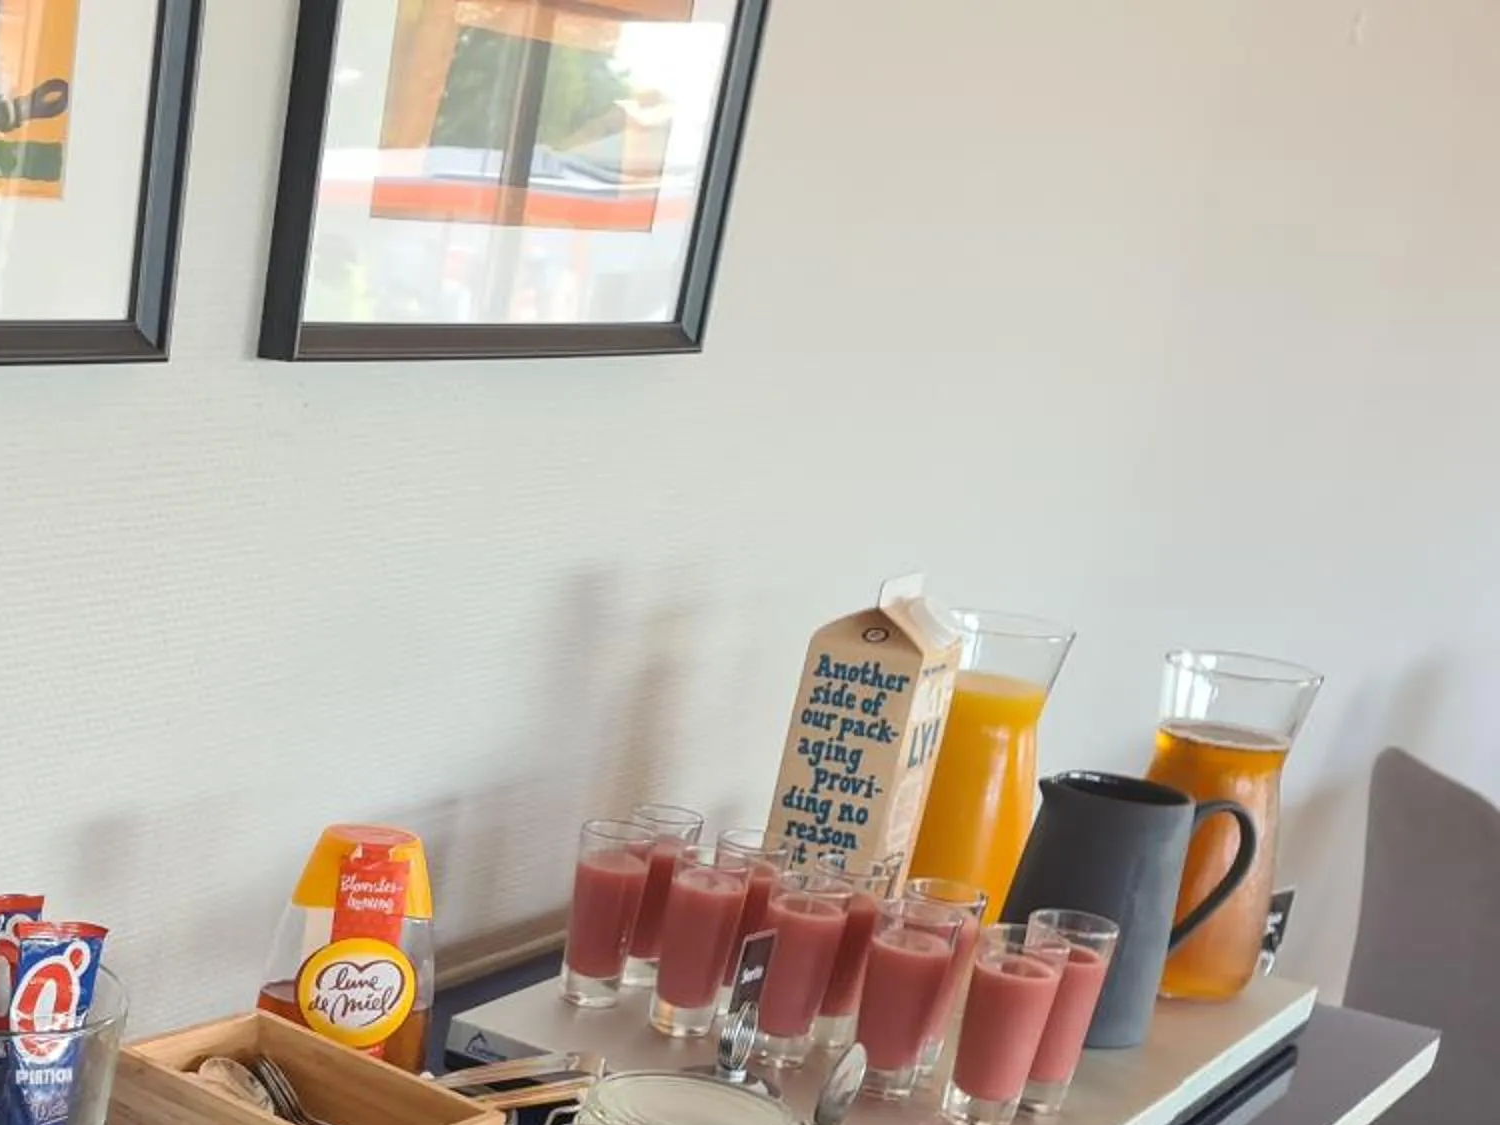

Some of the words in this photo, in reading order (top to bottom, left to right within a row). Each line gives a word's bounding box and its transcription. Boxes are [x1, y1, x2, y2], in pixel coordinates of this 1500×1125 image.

[813, 653, 910, 692] Another
[809, 682, 857, 710] side
[861, 692, 887, 716] of
[801, 708, 838, 731] our
[837, 717, 899, 743] pack-
[798, 737, 863, 774] aging
[782, 785, 833, 824] ding
[838, 802, 868, 824] no
[784, 820, 857, 850] reason
[329, 967, 378, 991] lune
[308, 995, 330, 1013] de
